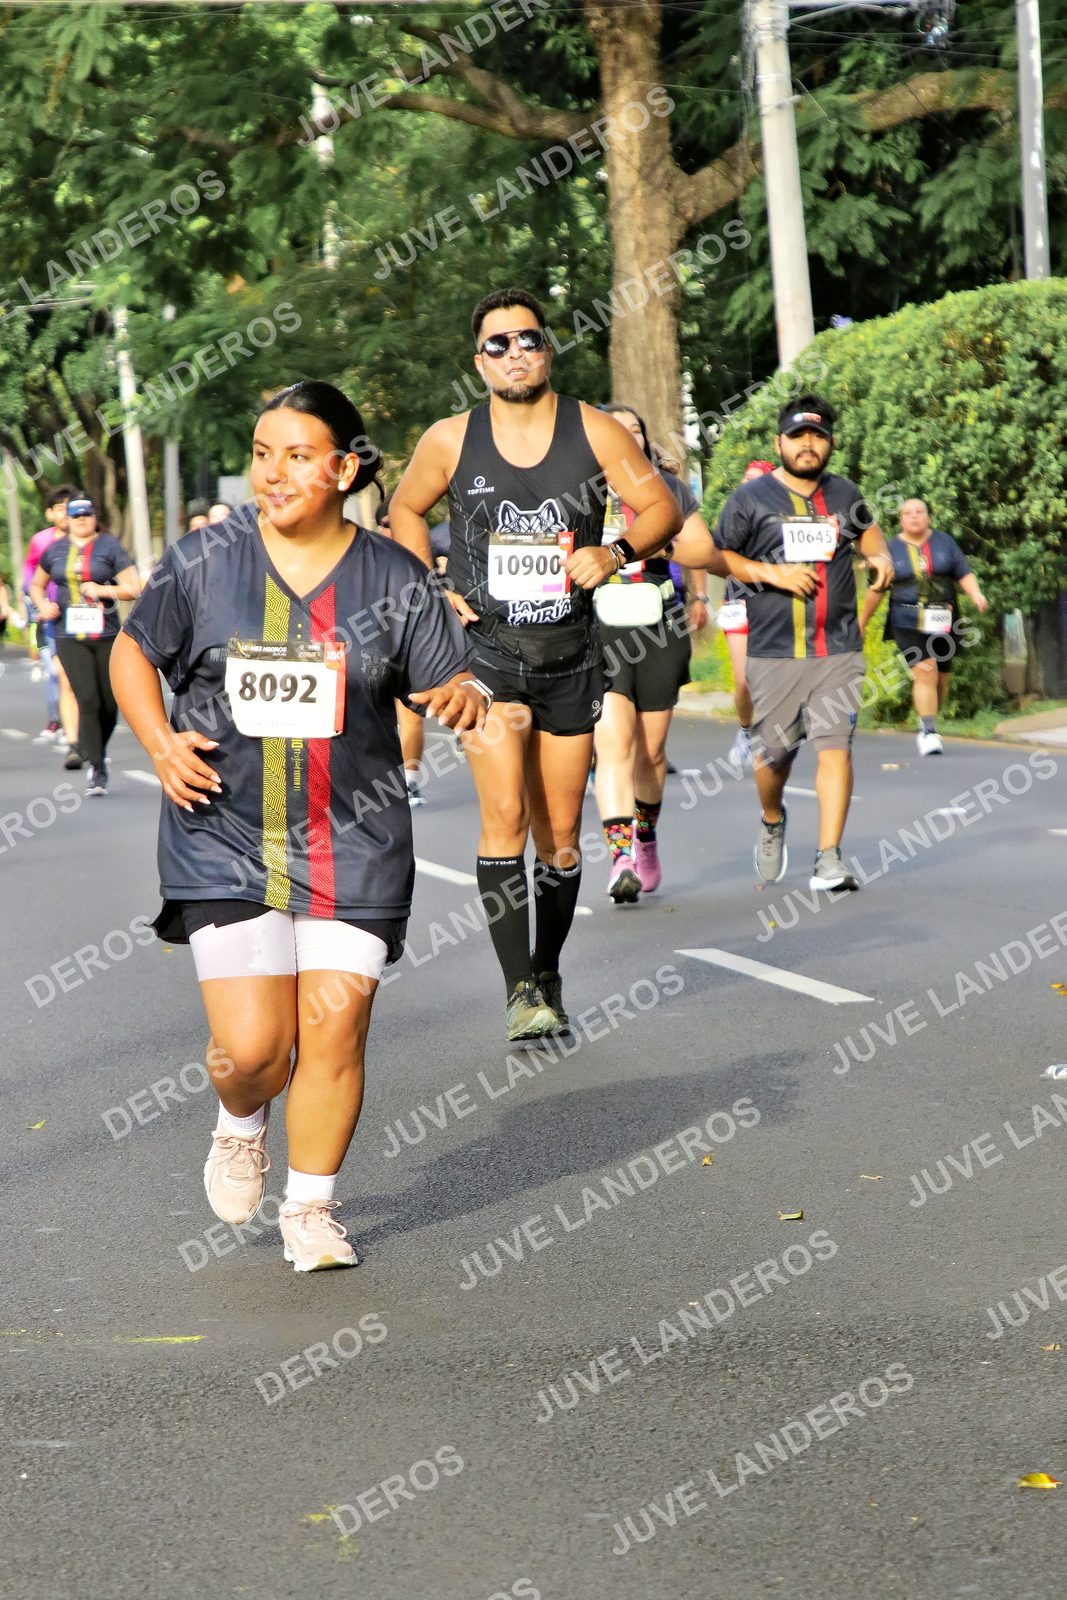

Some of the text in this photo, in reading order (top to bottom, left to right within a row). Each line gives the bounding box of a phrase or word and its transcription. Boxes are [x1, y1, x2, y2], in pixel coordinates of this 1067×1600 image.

[467, 486, 495, 495] TOPTIME
[789, 530, 832, 543] 10645
[494, 554, 562, 576] 10900
[239, 671, 317, 703] 8092
